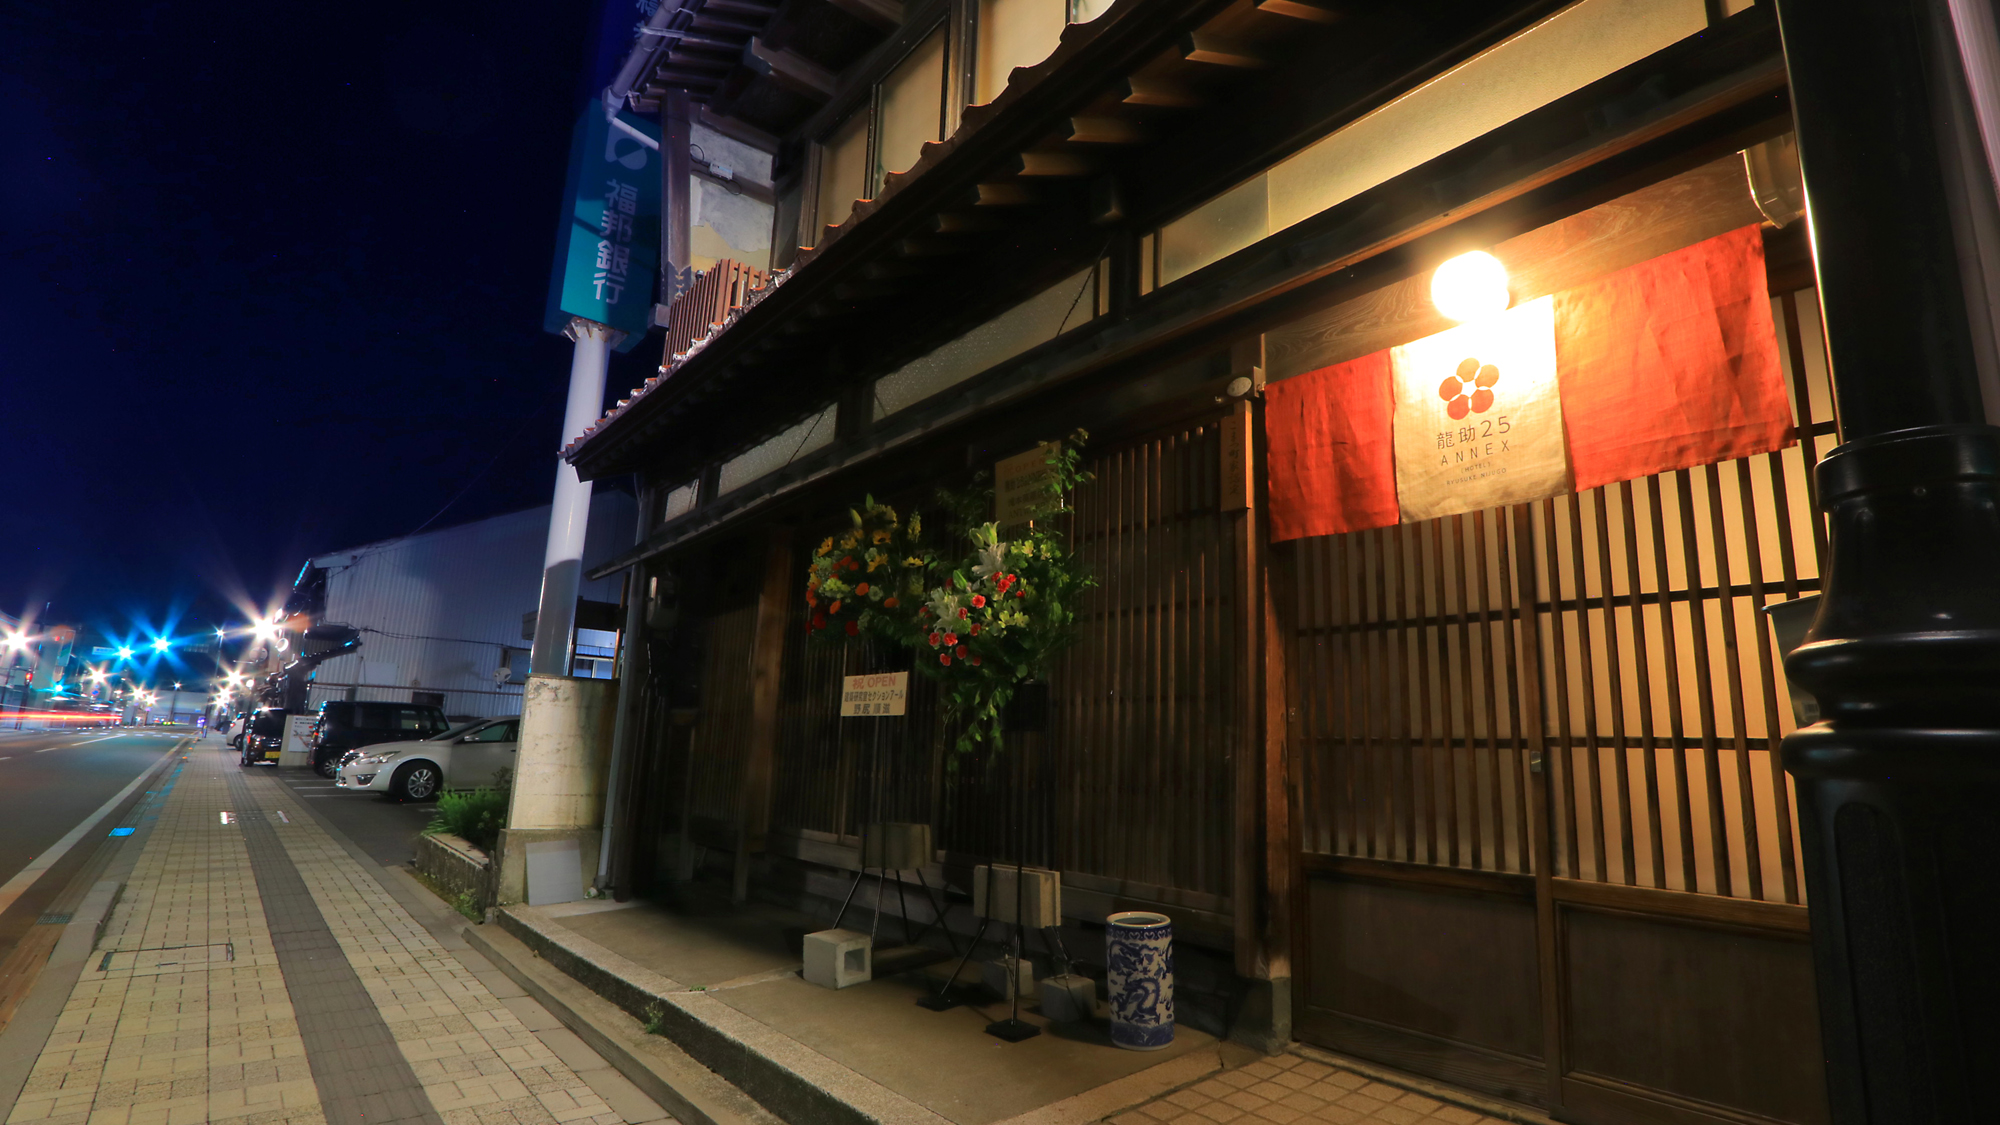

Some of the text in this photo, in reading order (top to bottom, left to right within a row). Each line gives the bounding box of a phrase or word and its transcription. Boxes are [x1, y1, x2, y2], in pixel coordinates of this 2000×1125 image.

[593, 178, 638, 304] 福邦銀行
[1440, 440, 1510, 466] ANNEX
[1446, 467, 1507, 486] RYUSUKE NIJUGO
[867, 675, 896, 688] OPEN
